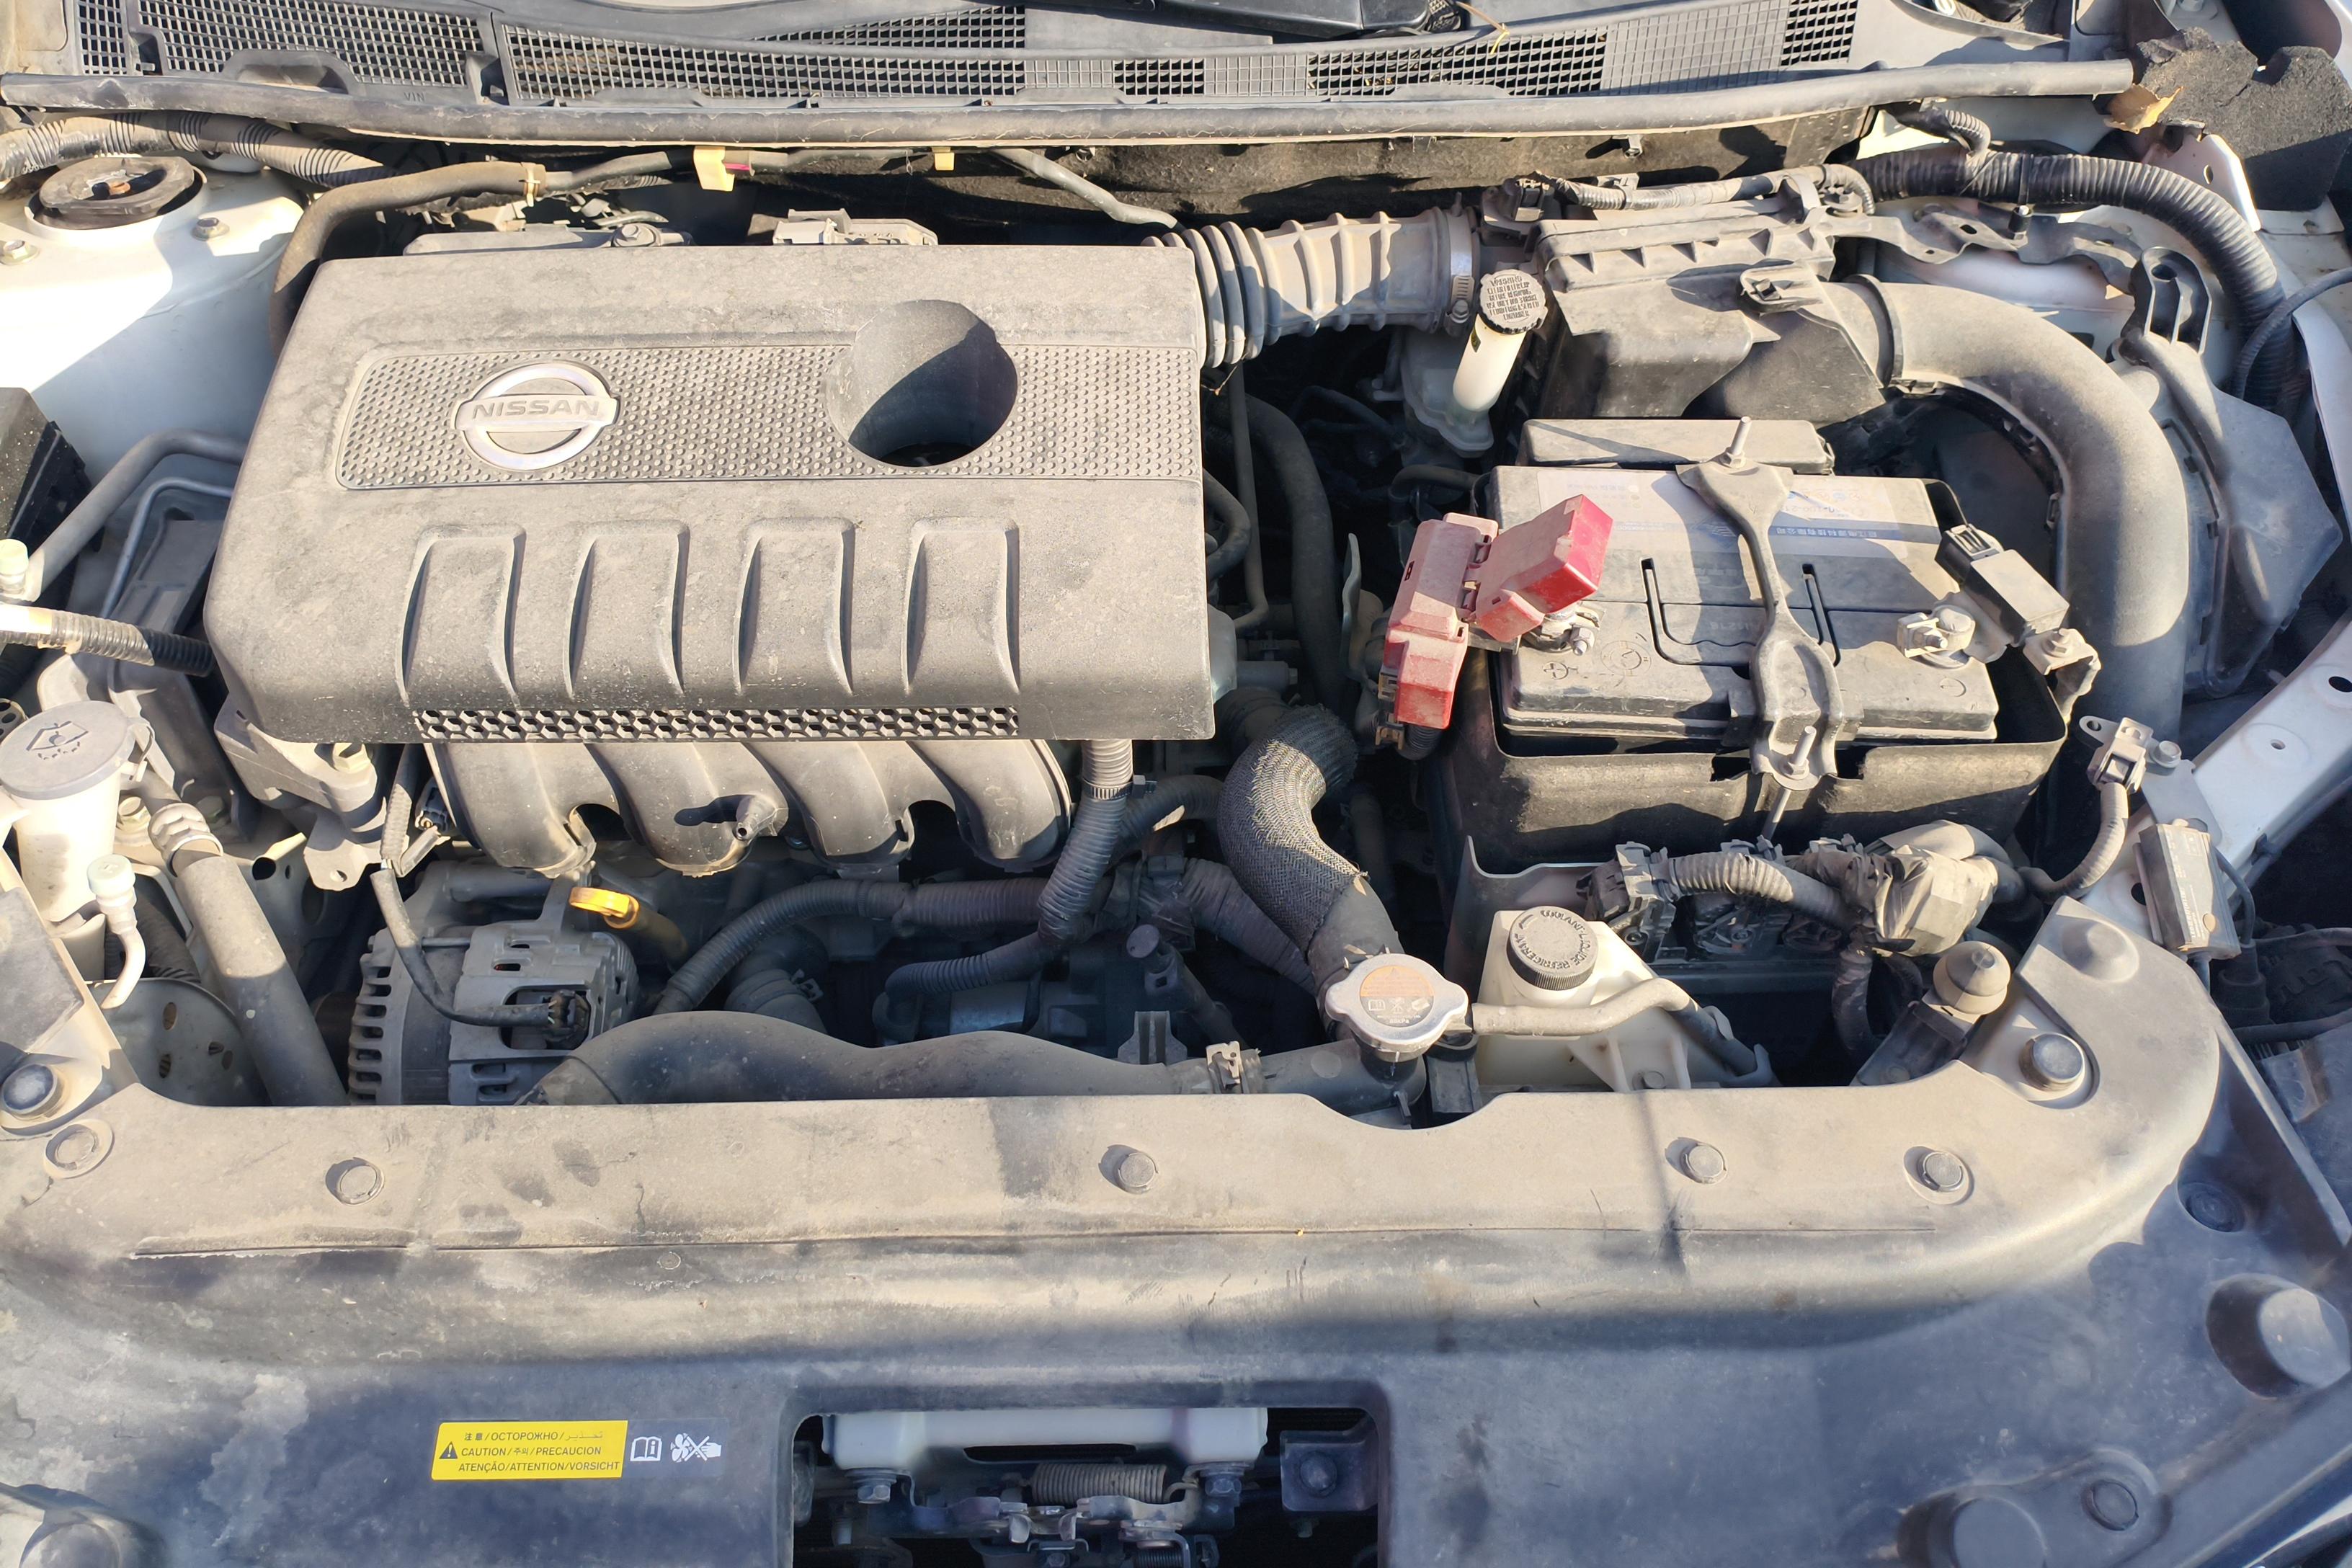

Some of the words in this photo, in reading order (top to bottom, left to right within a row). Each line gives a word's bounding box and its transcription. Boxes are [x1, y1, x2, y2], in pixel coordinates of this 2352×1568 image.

[404, 92, 425, 102] VIN
[1489, 275, 1523, 287] WARNING
[472, 399, 600, 419] NISSAN
